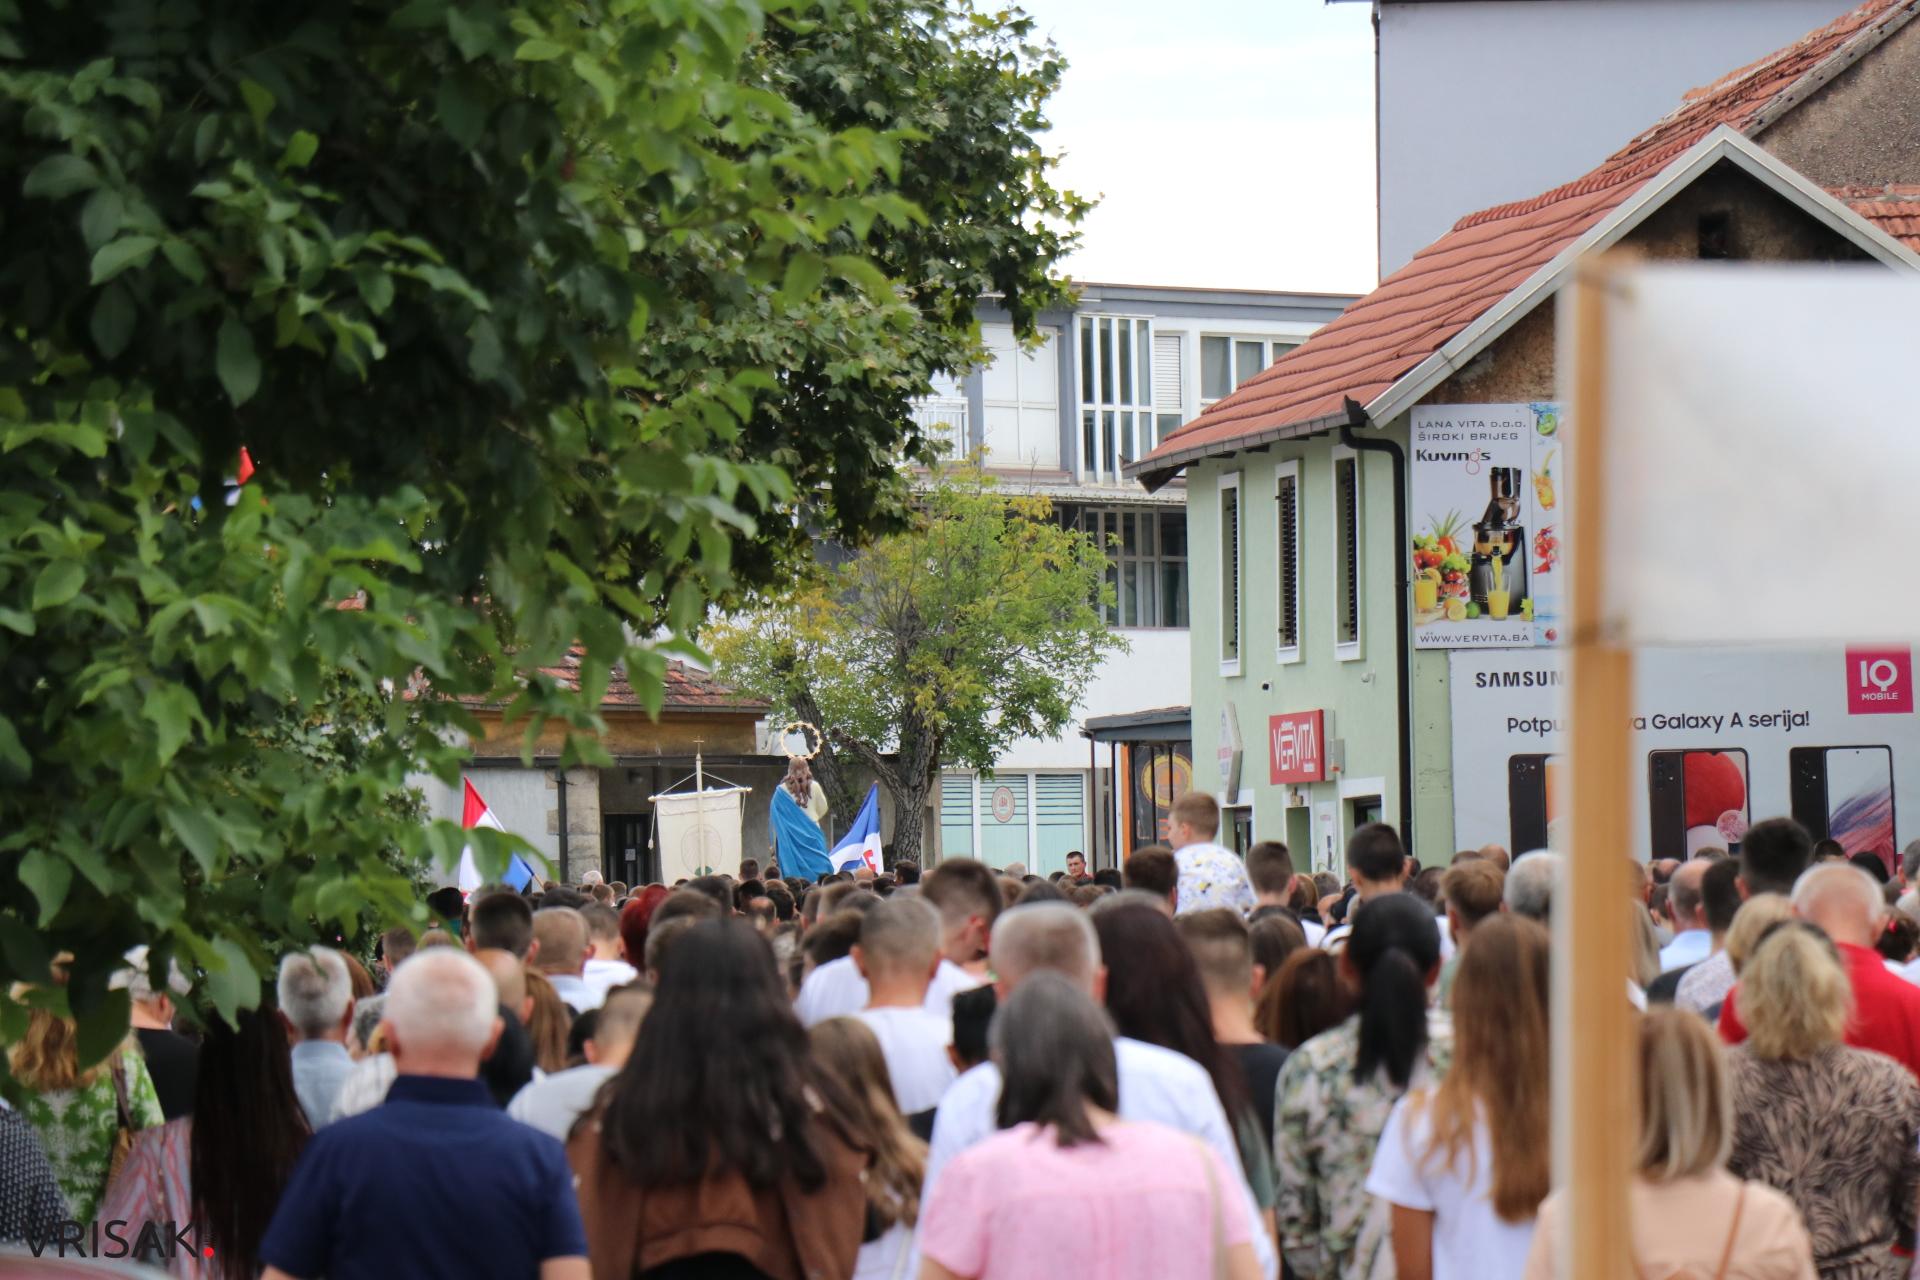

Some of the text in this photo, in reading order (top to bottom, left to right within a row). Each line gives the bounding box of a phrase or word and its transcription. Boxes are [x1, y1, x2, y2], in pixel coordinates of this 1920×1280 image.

[1417, 420, 1453, 429] LANA
[1457, 420, 1486, 428] VITA
[1417, 431, 1519, 441] ŠIROKI BRIJEG
[1416, 448, 1491, 475] Kuvings
[1420, 634, 1529, 643] WWW.VERVITA.BA
[1475, 670, 1566, 688] SAMSUN
[1860, 659, 1898, 692] IQ
[1861, 692, 1899, 701] MOBILE
[1507, 716, 1567, 738] Potpu
[1651, 713, 1724, 734] Galaxy
[1730, 712, 1743, 728] A
[1748, 710, 1810, 732] serija!
